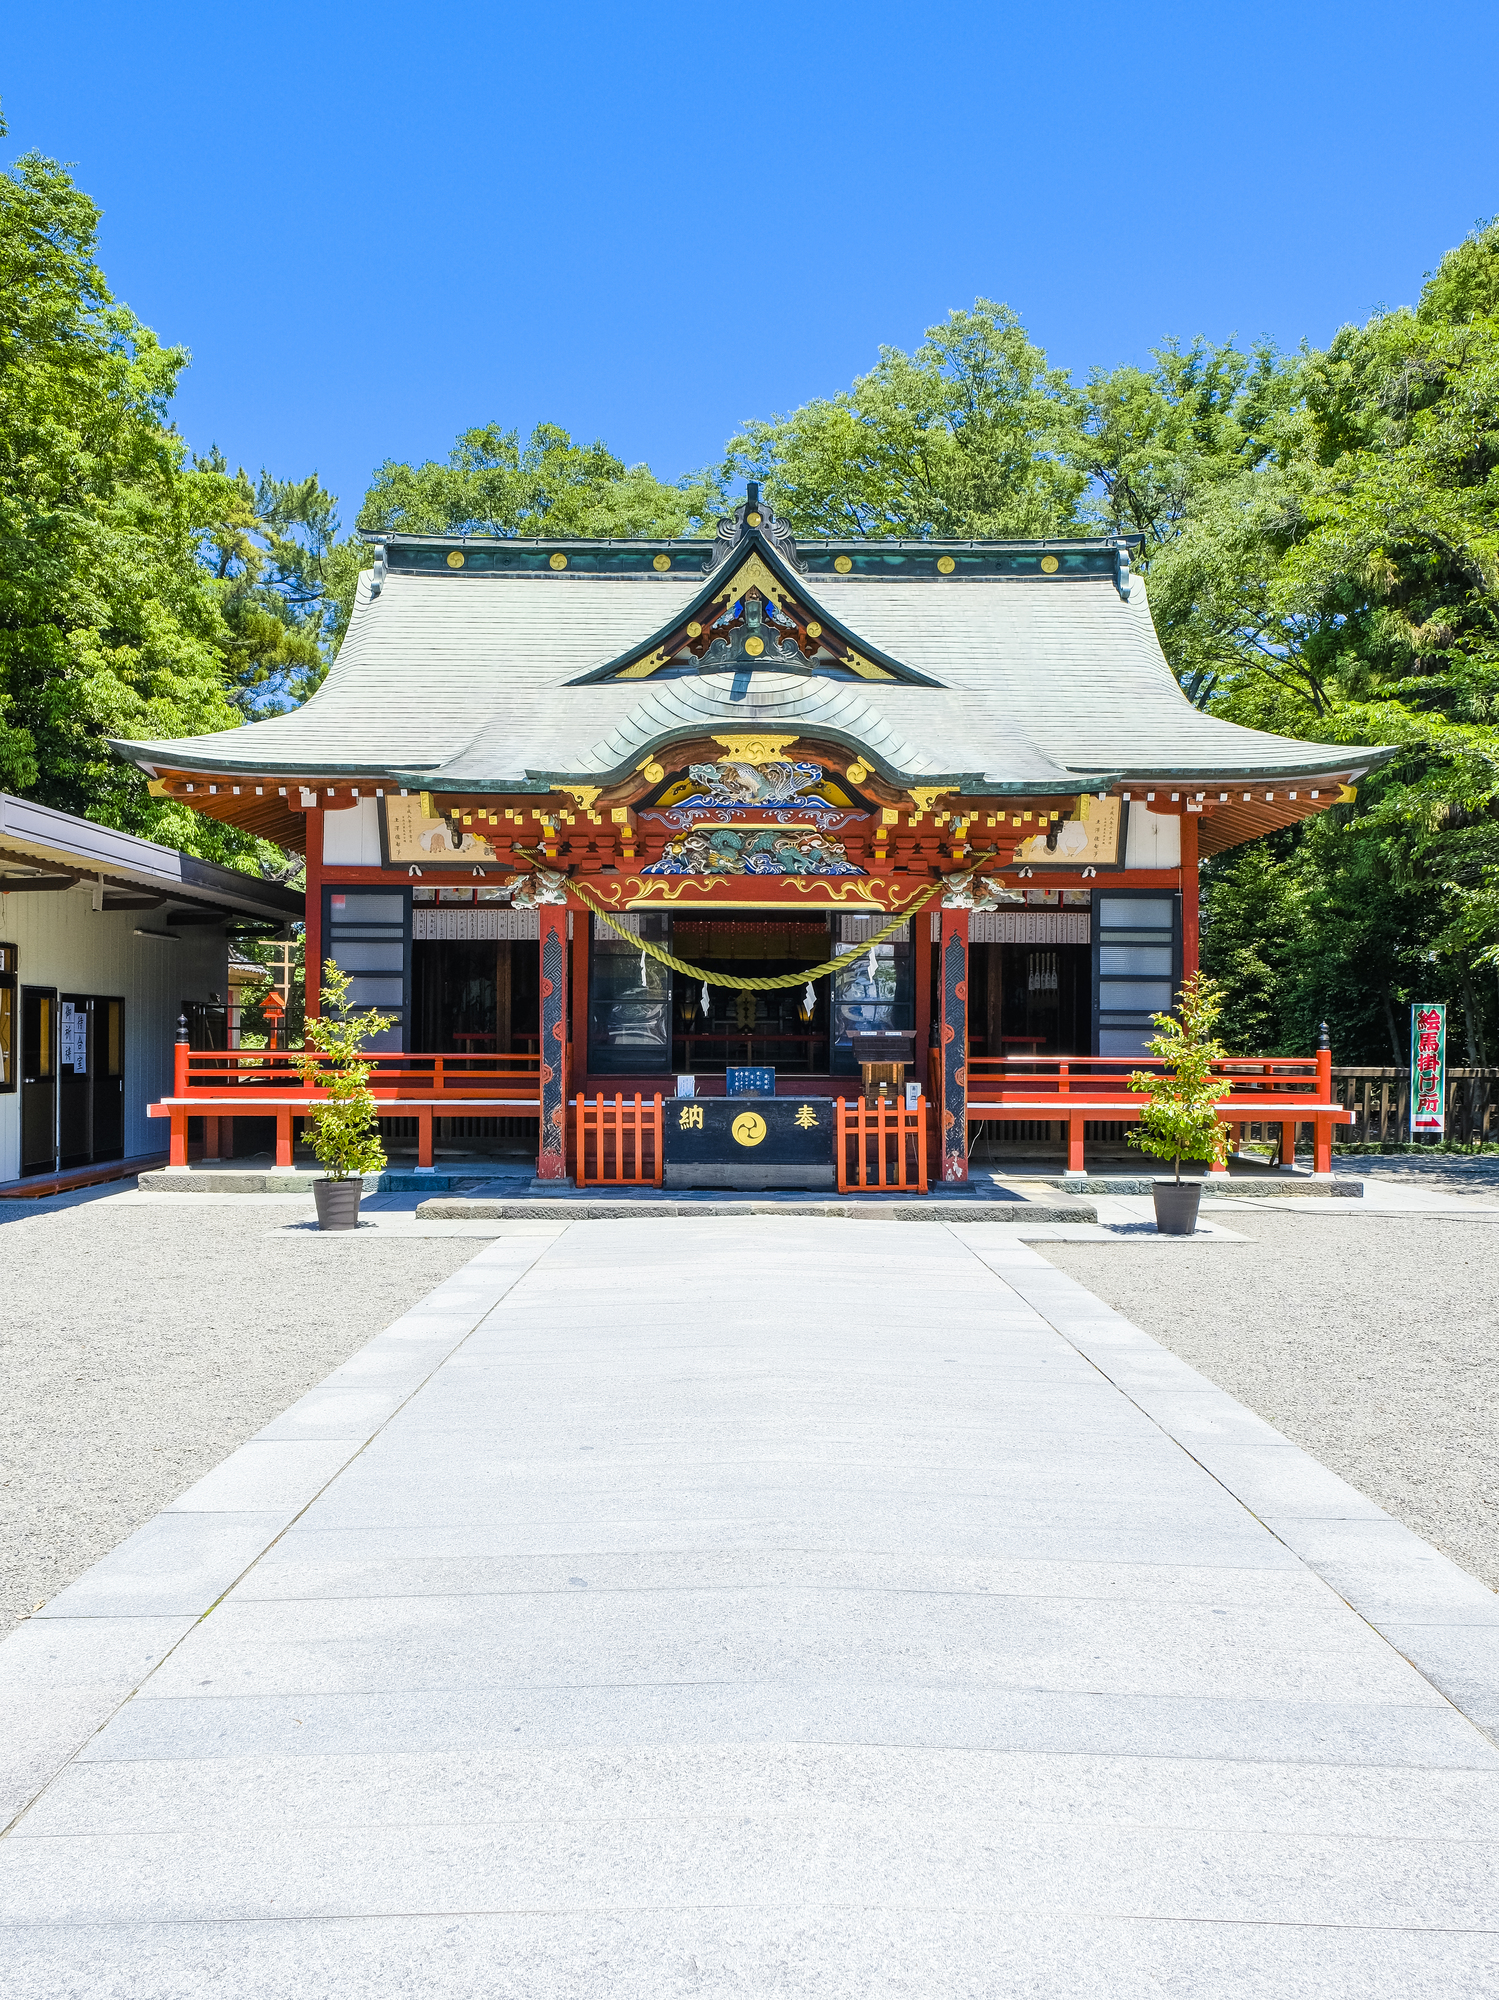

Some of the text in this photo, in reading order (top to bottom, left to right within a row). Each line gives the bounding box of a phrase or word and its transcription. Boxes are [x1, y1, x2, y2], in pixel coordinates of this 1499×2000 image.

[1416, 1008, 1441, 1113] 絵馬掛け所
[679, 1104, 704, 1131] 納
[794, 1104, 819, 1130] 奉
